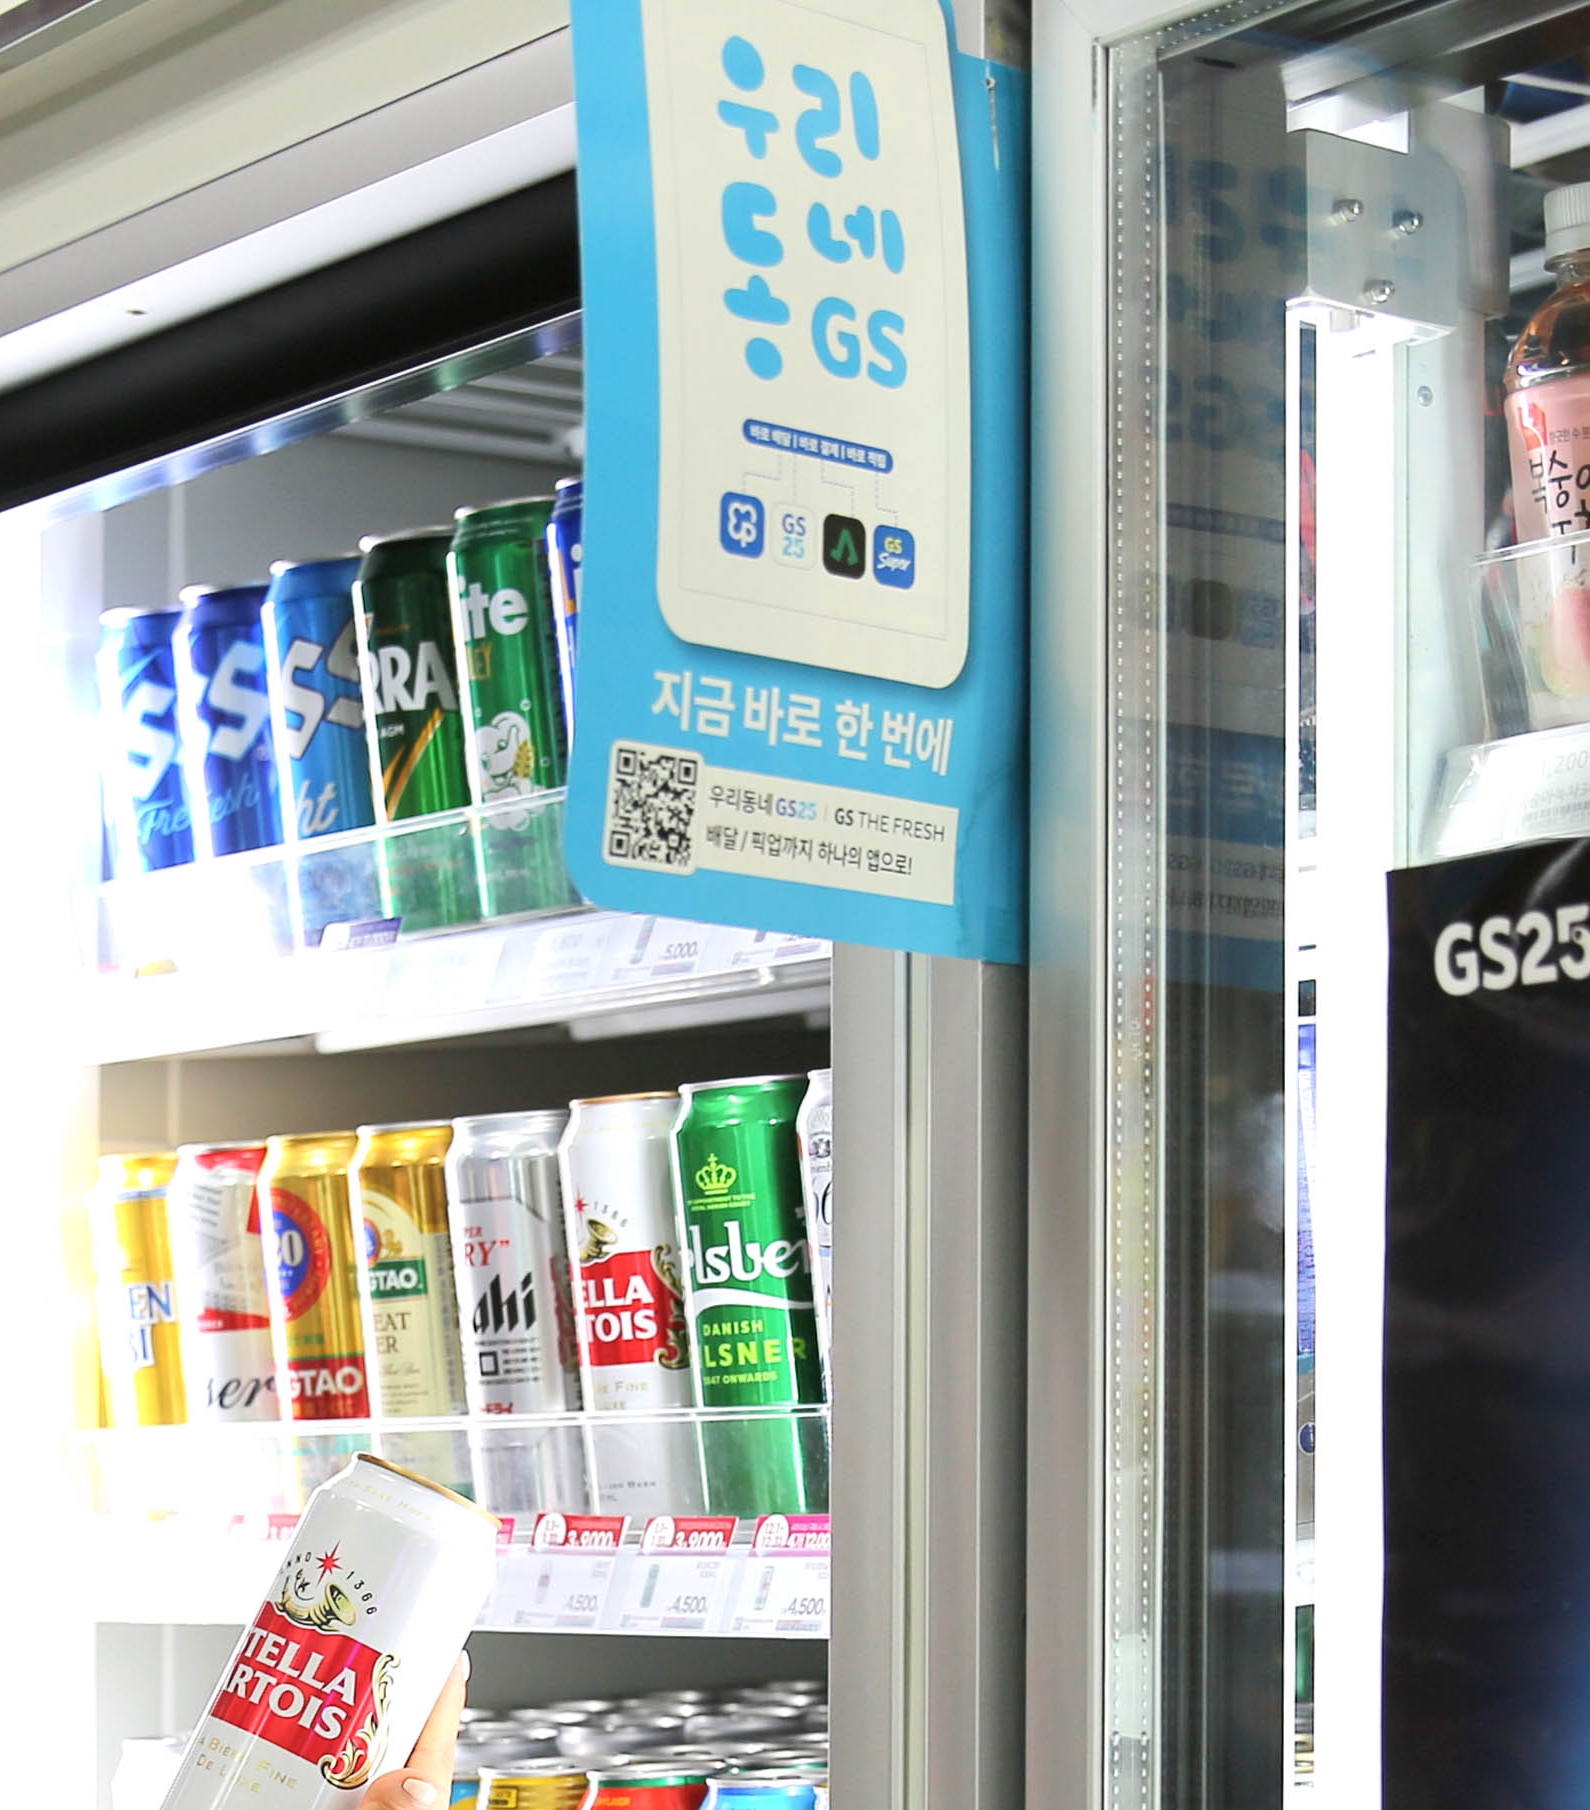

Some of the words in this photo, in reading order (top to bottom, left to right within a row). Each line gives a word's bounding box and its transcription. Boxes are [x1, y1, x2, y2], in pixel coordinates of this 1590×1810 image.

[718, 36, 880, 178] 우리
[721, 182, 905, 380] 동네
[812, 297, 907, 389] GS
[782, 514, 806, 536] GS
[782, 536, 805, 558] 25
[651, 670, 735, 738] 지금
[744, 686, 822, 748] 바로
[836, 700, 873, 760] 한
[881, 710, 954, 776] 번에
[706, 825, 738, 850] 배달
[752, 832, 812, 863] 픽업까지
[818, 841, 862, 869] 하나의
[835, 808, 854, 826] GS
[859, 811, 890, 832] THE
[893, 817, 945, 842] FRESH
[702, 1319, 764, 1337] DANISH
[346, 1570, 377, 1616] 1366
